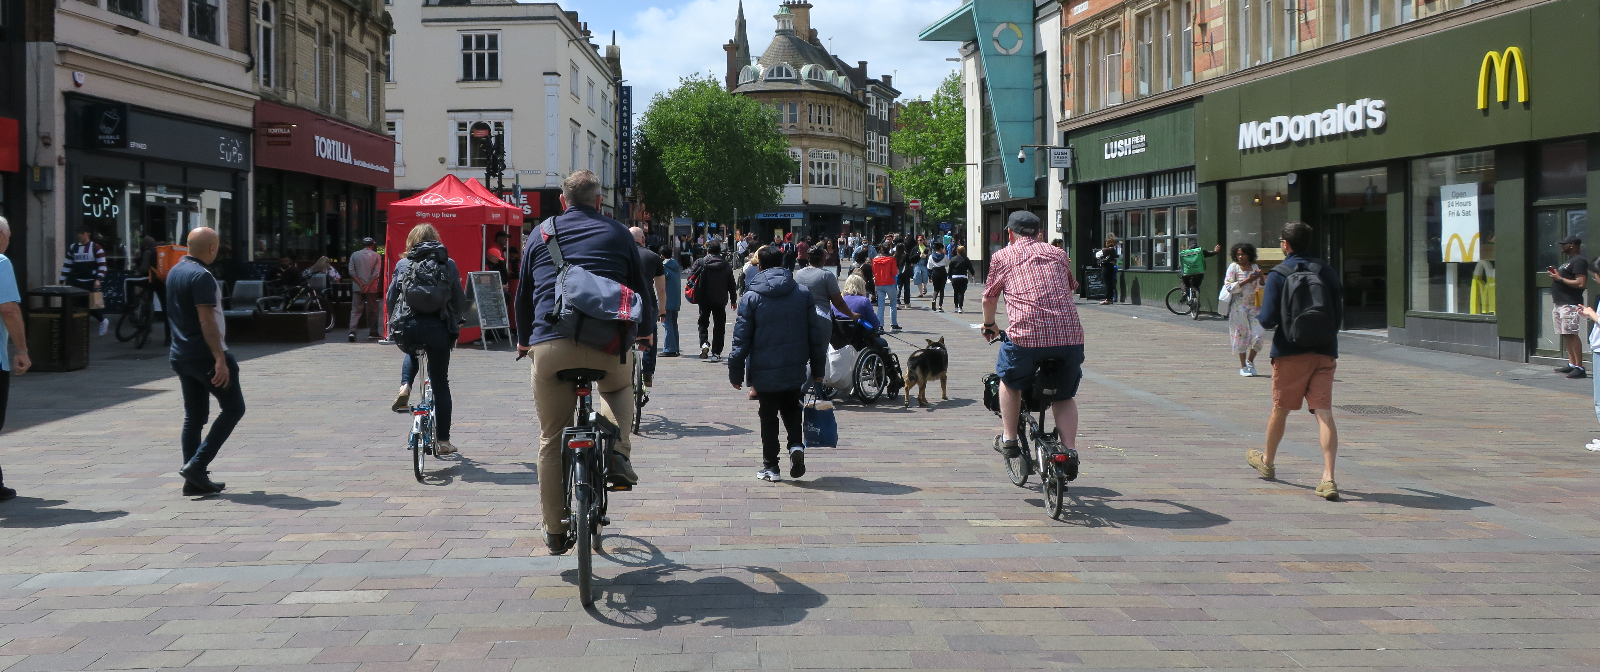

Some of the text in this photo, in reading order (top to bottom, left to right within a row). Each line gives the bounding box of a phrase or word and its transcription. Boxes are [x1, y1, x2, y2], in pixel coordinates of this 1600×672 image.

[1238, 97, 1387, 150] McDonald's
[314, 135, 353, 165] TORTILLA
[1104, 137, 1132, 160] LUSH
[1132, 134, 1146, 145] FRESH
[1451, 191, 1467, 199] Open
